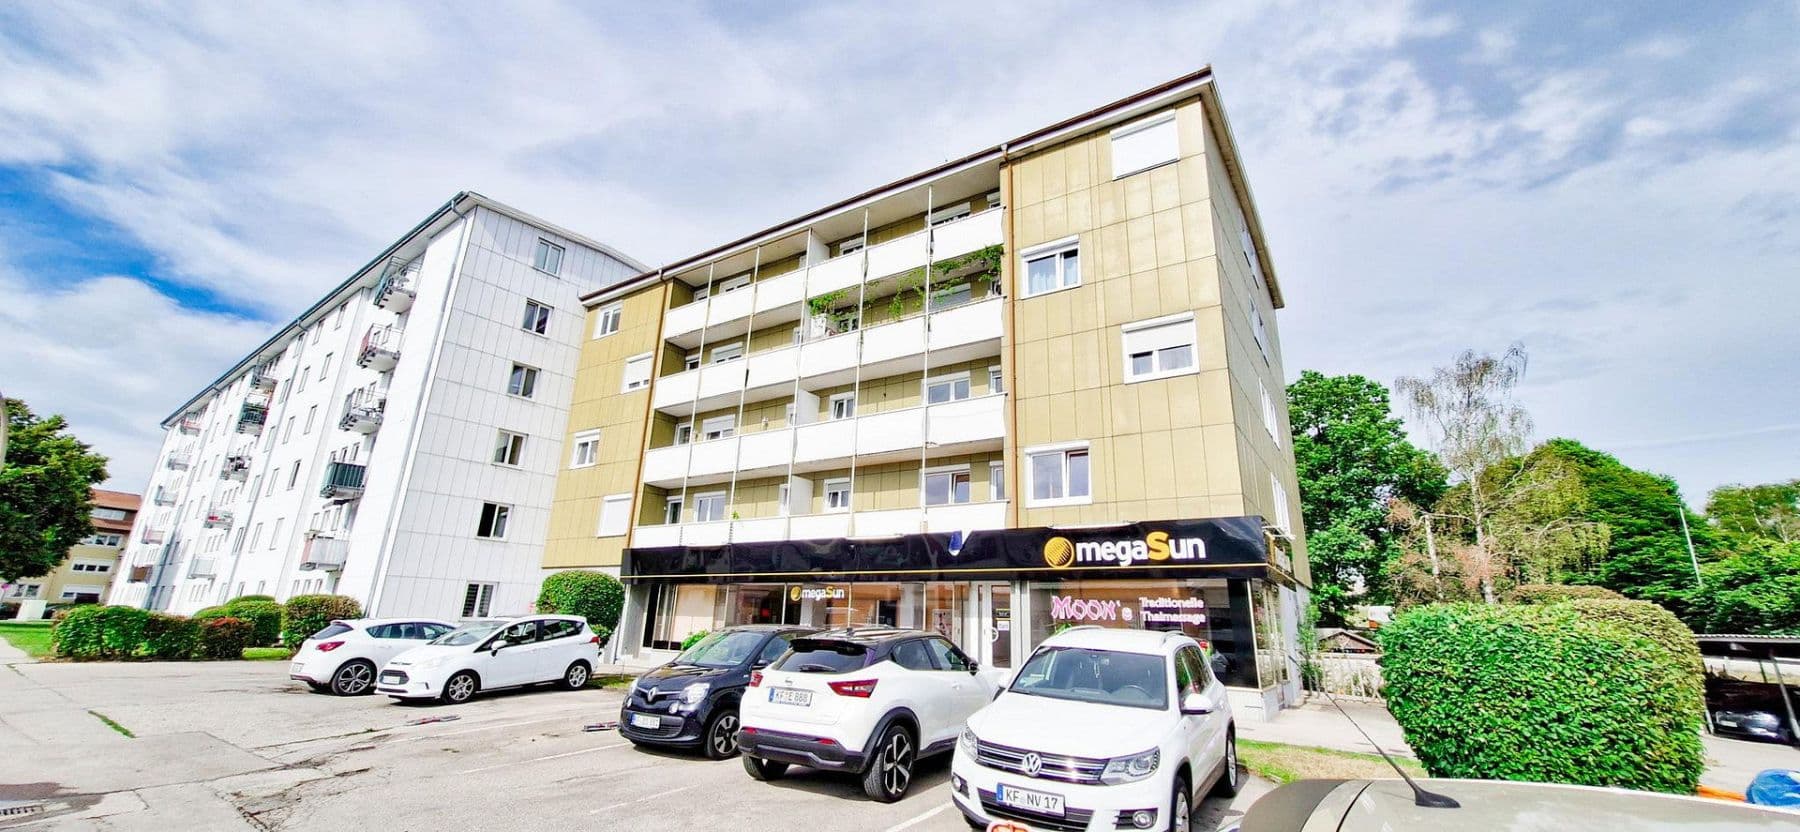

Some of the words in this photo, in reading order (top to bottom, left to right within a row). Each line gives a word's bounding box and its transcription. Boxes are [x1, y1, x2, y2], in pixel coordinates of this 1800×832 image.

[1075, 531, 1207, 567] megaSun
[801, 586, 845, 601] megaSun
[1138, 596, 1205, 609] Traditionelle
[1005, 788, 1020, 802] KF
[1026, 793, 1042, 807] NV
[1044, 795, 1059, 809] 17
